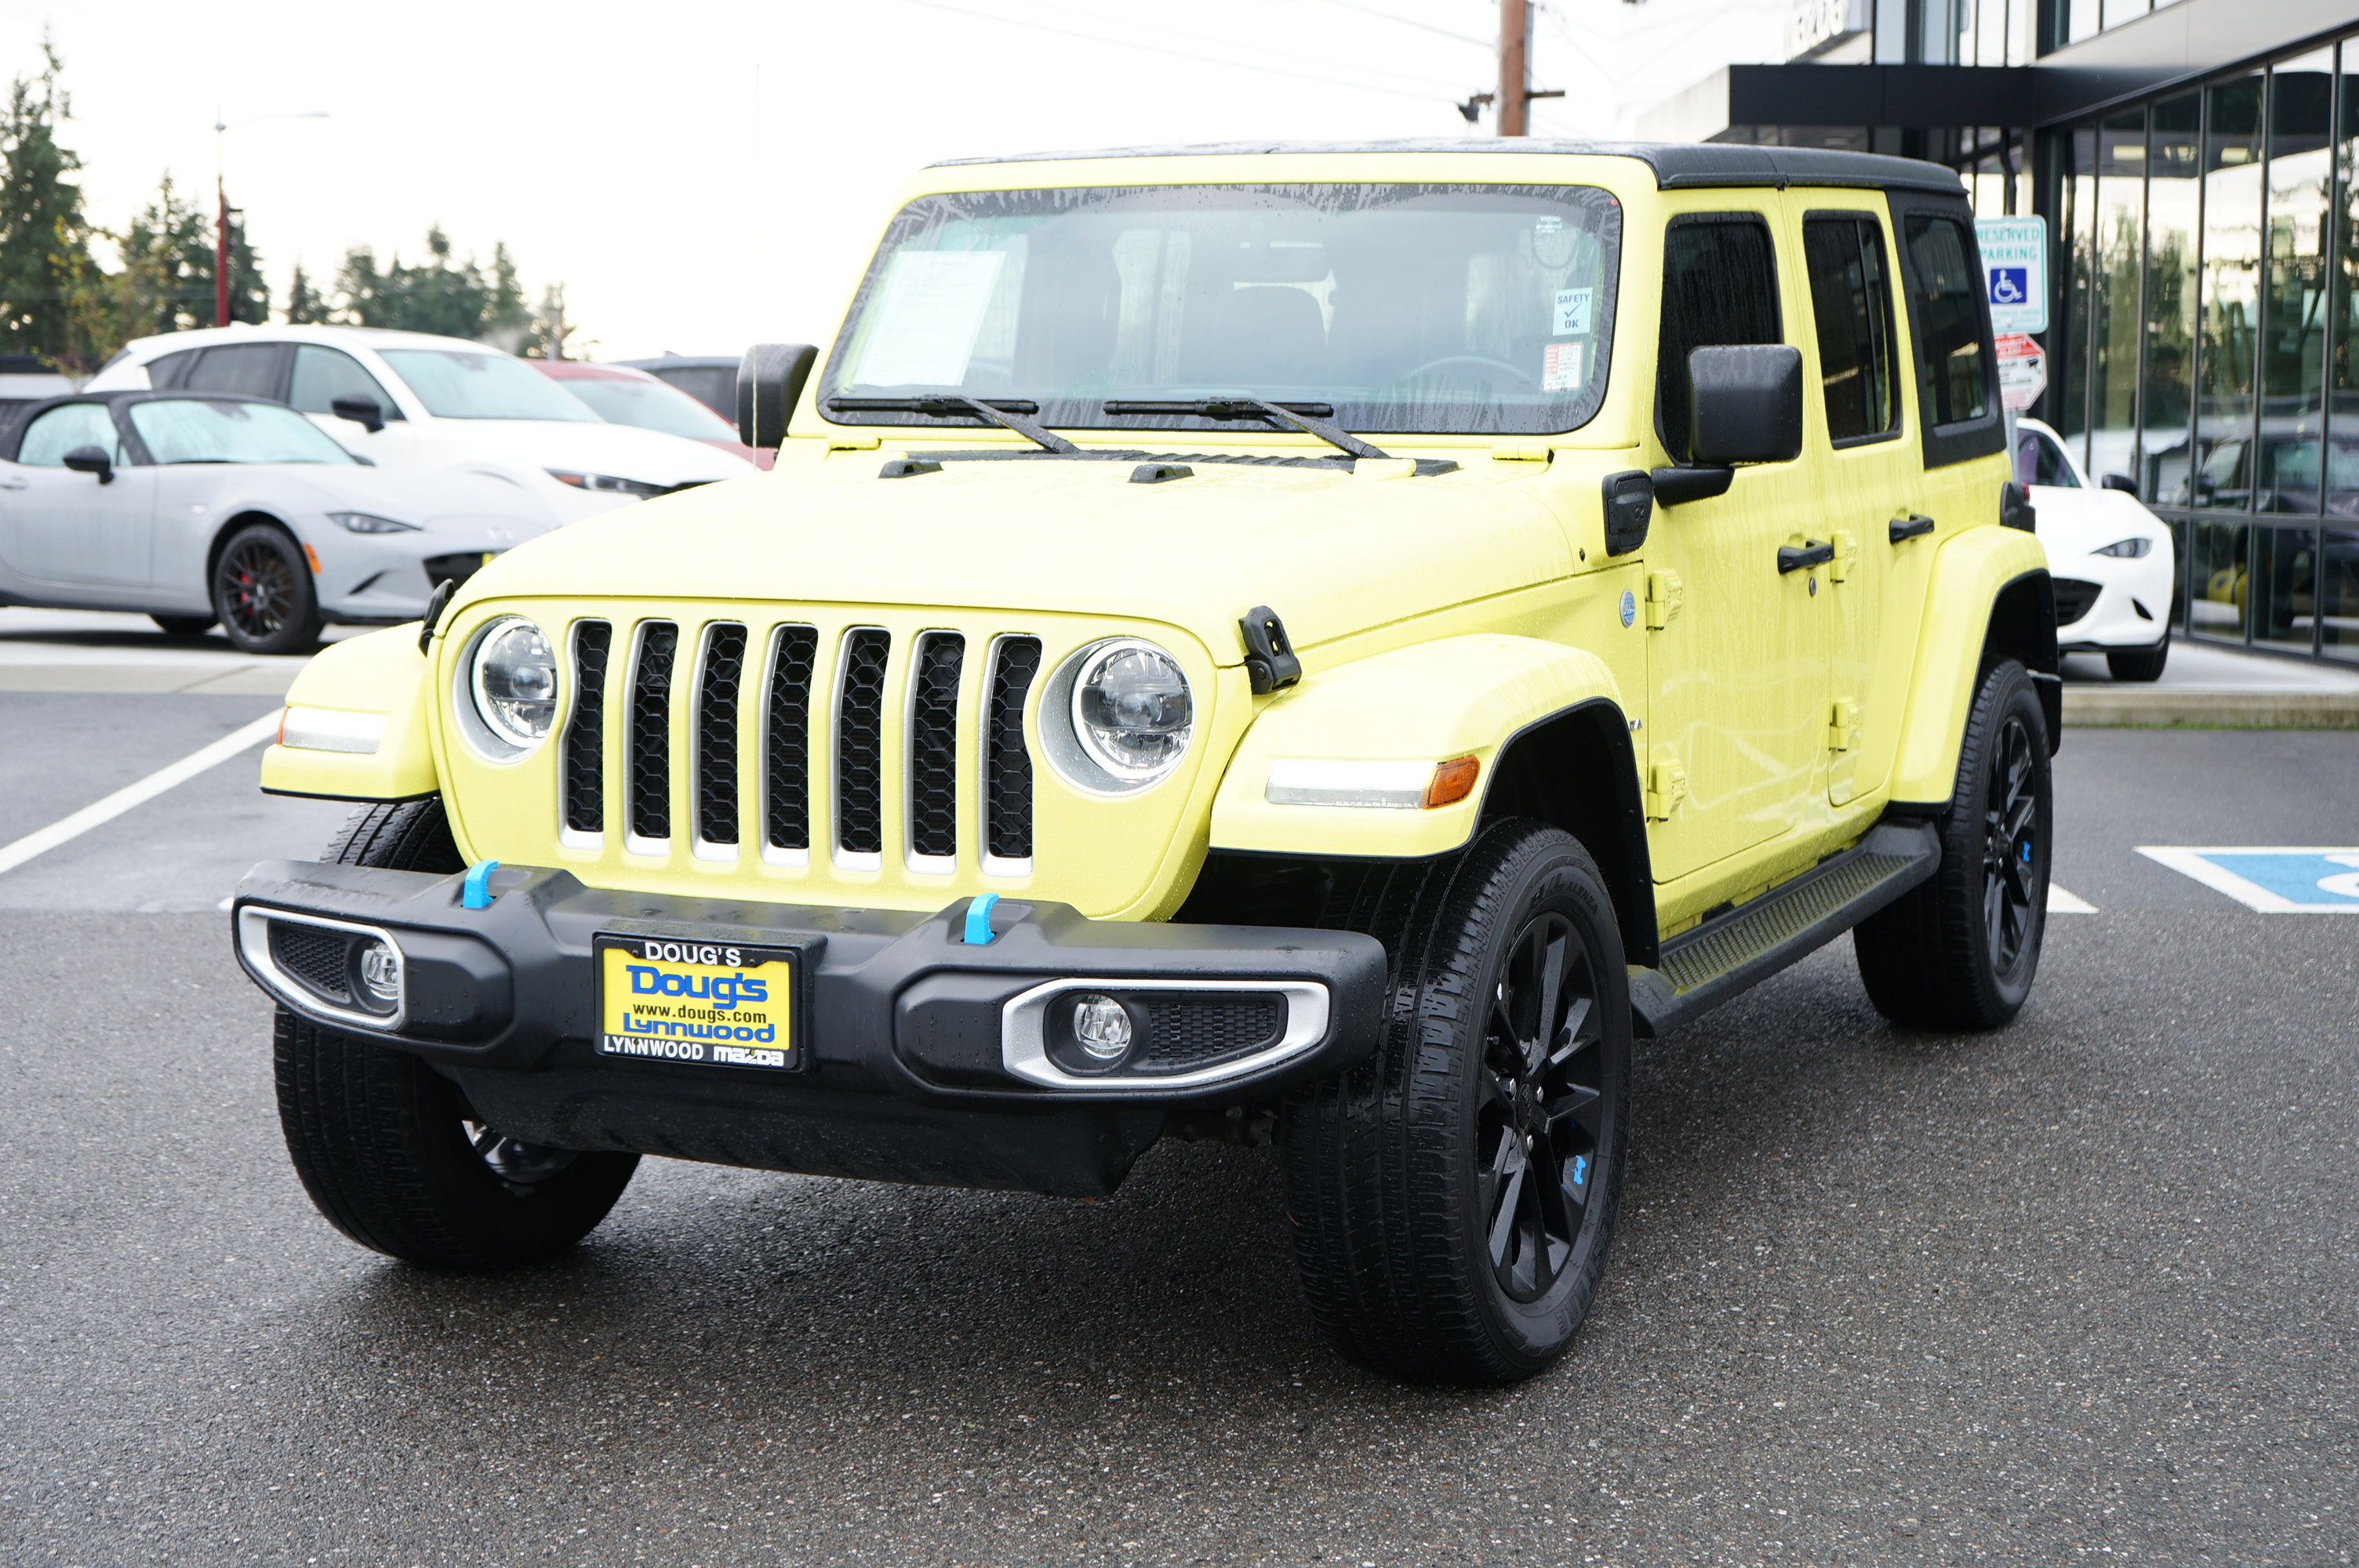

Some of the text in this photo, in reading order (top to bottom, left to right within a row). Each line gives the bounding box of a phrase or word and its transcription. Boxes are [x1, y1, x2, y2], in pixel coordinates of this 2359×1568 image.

[1558, 293, 1589, 304] SAFETY
[1565, 319, 1579, 328] OK
[1567, 881, 1599, 914] ALENZA
[645, 942, 741, 967] DOUG'S
[633, 1004, 767, 1023] www.dougs.com
[623, 1012, 775, 1043] Lynnwood
[604, 1035, 703, 1060] LYNNWOOD
